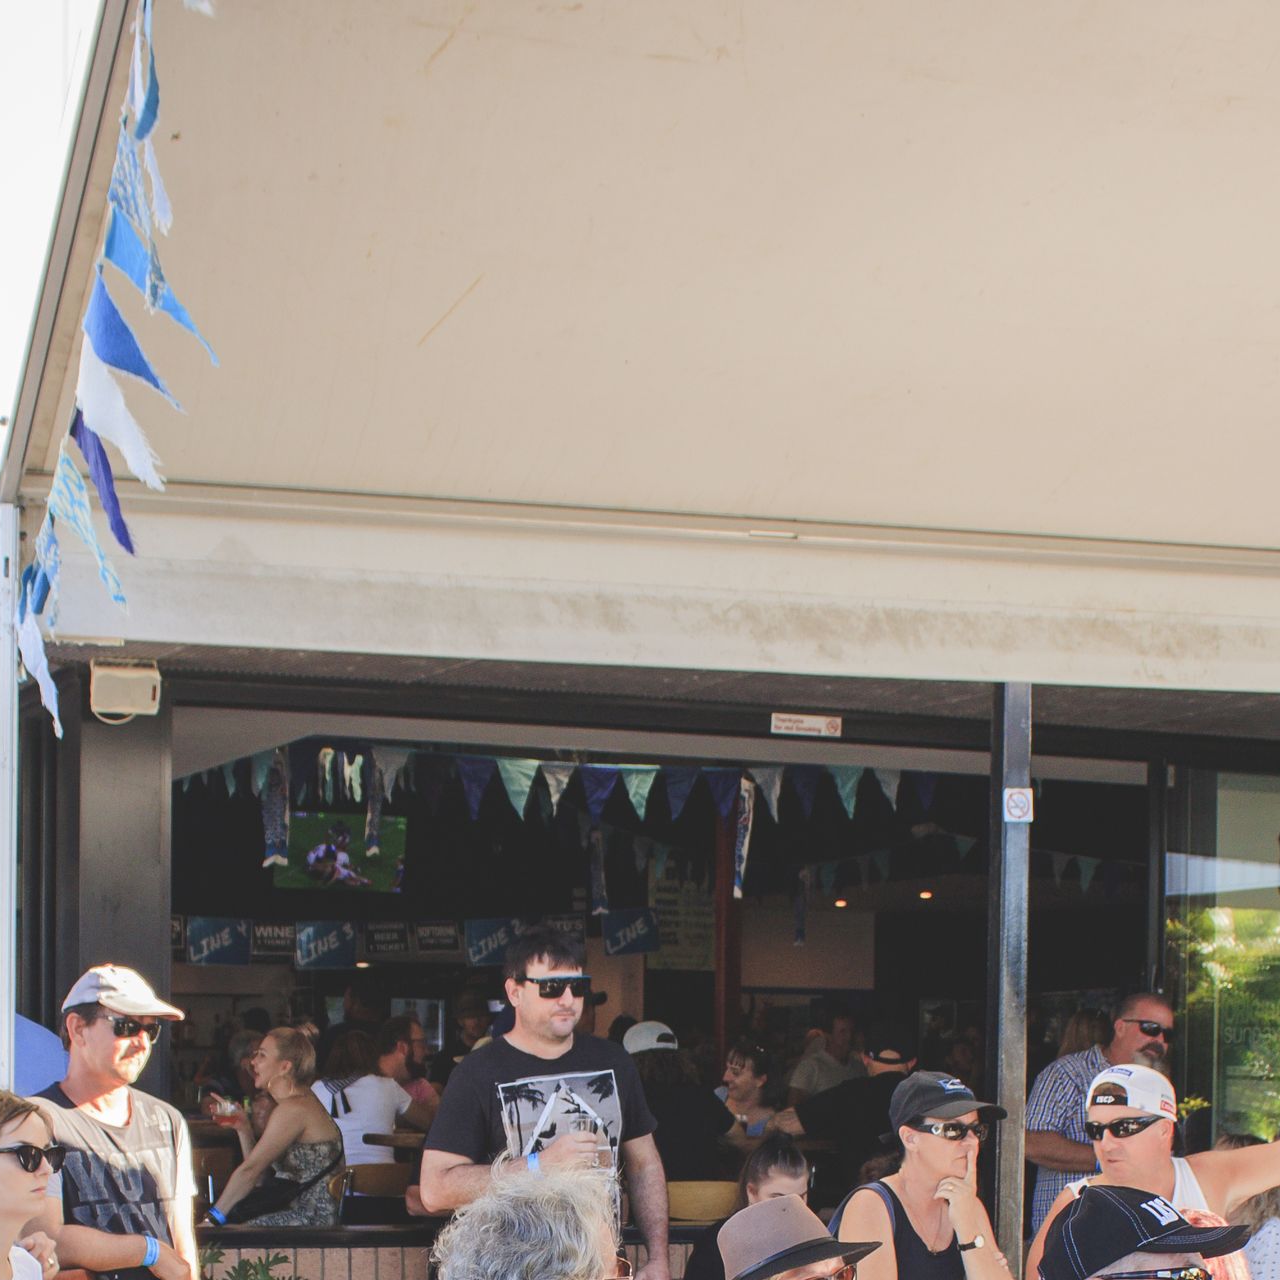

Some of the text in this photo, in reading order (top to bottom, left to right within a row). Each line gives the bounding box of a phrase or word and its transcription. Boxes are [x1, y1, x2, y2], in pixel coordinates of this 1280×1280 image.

[190, 926, 233, 962] LINE
[254, 925, 296, 938] WINE
[296, 921, 354, 966] LINE 3
[468, 926, 510, 961] LINE
[606, 917, 649, 954] LINE
